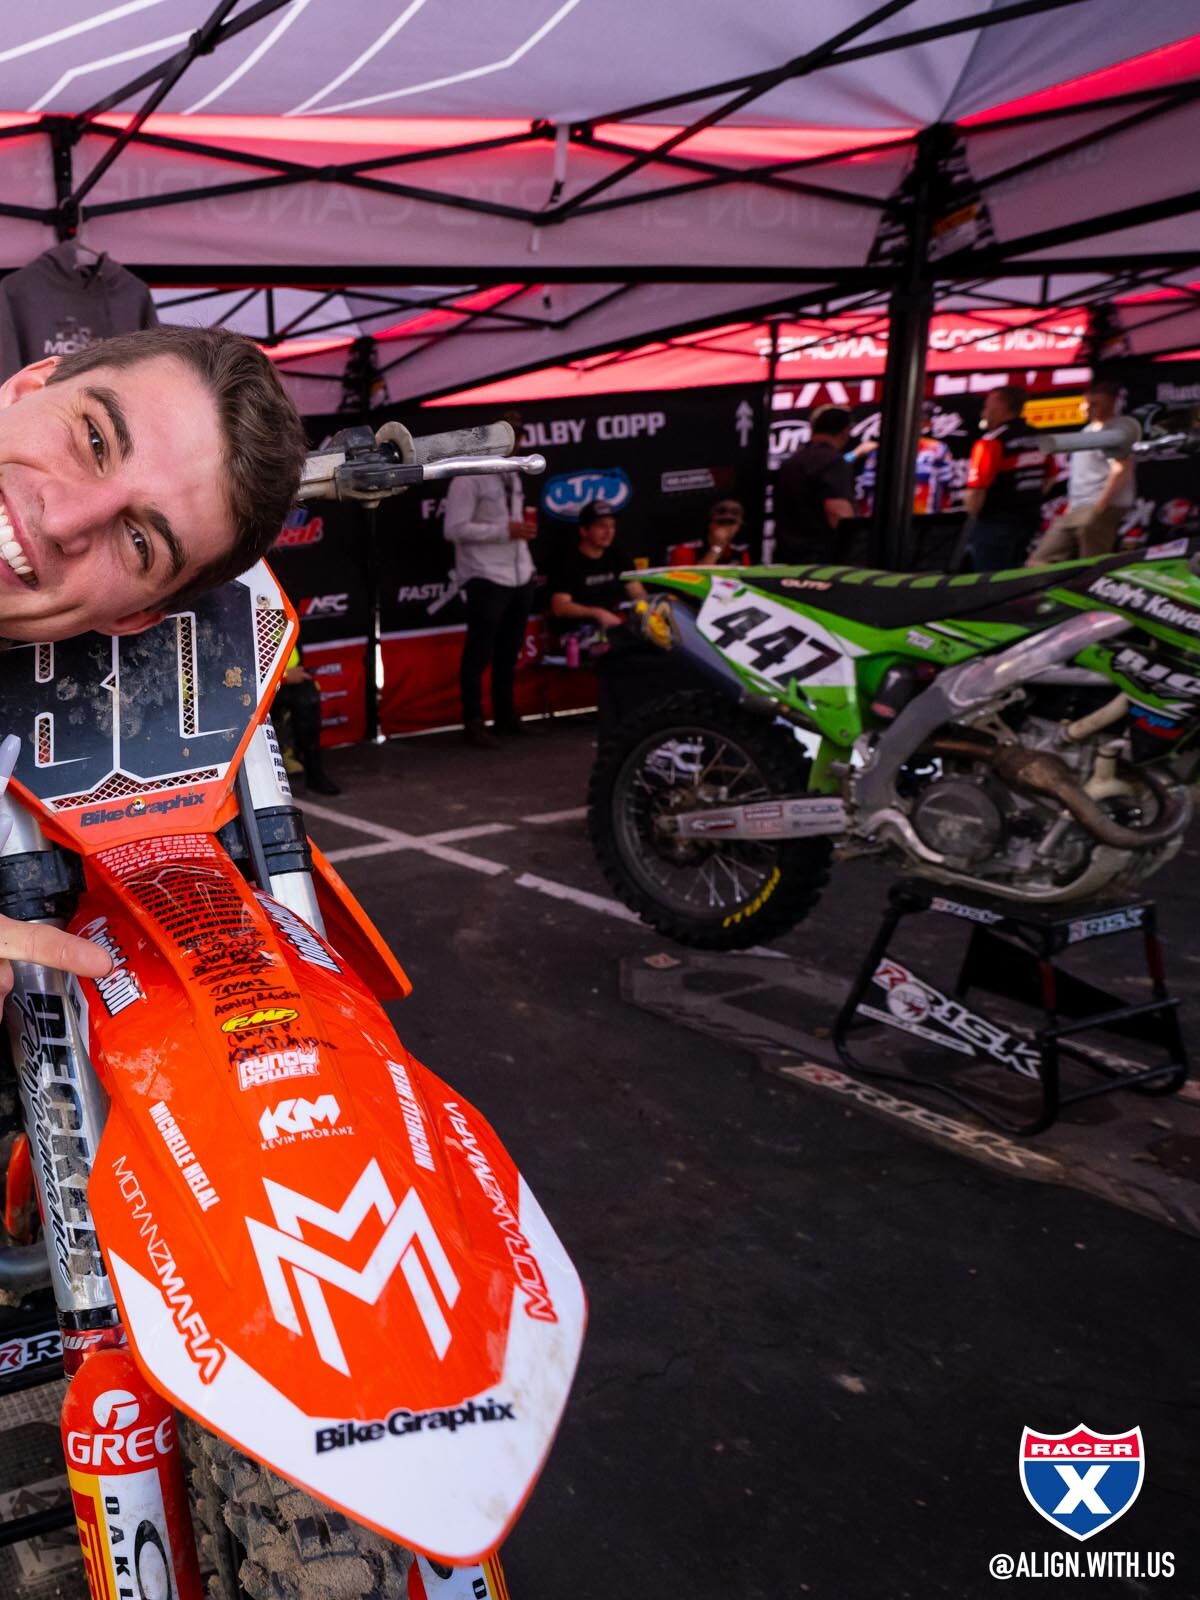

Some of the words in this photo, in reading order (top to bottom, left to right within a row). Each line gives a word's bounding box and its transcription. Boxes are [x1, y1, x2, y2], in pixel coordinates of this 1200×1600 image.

[597, 412, 667, 440] COPP
[711, 606, 843, 689] 447
[222, 1009, 298, 1032] FMF
[240, 1063, 317, 1090] POWER
[258, 1094, 341, 1141] KM
[148, 1101, 197, 1173] MICHELLE
[260, 1133, 297, 1151] KEVIN
[300, 1126, 355, 1141] MORANZ
[67, 1415, 174, 1467] GREE
